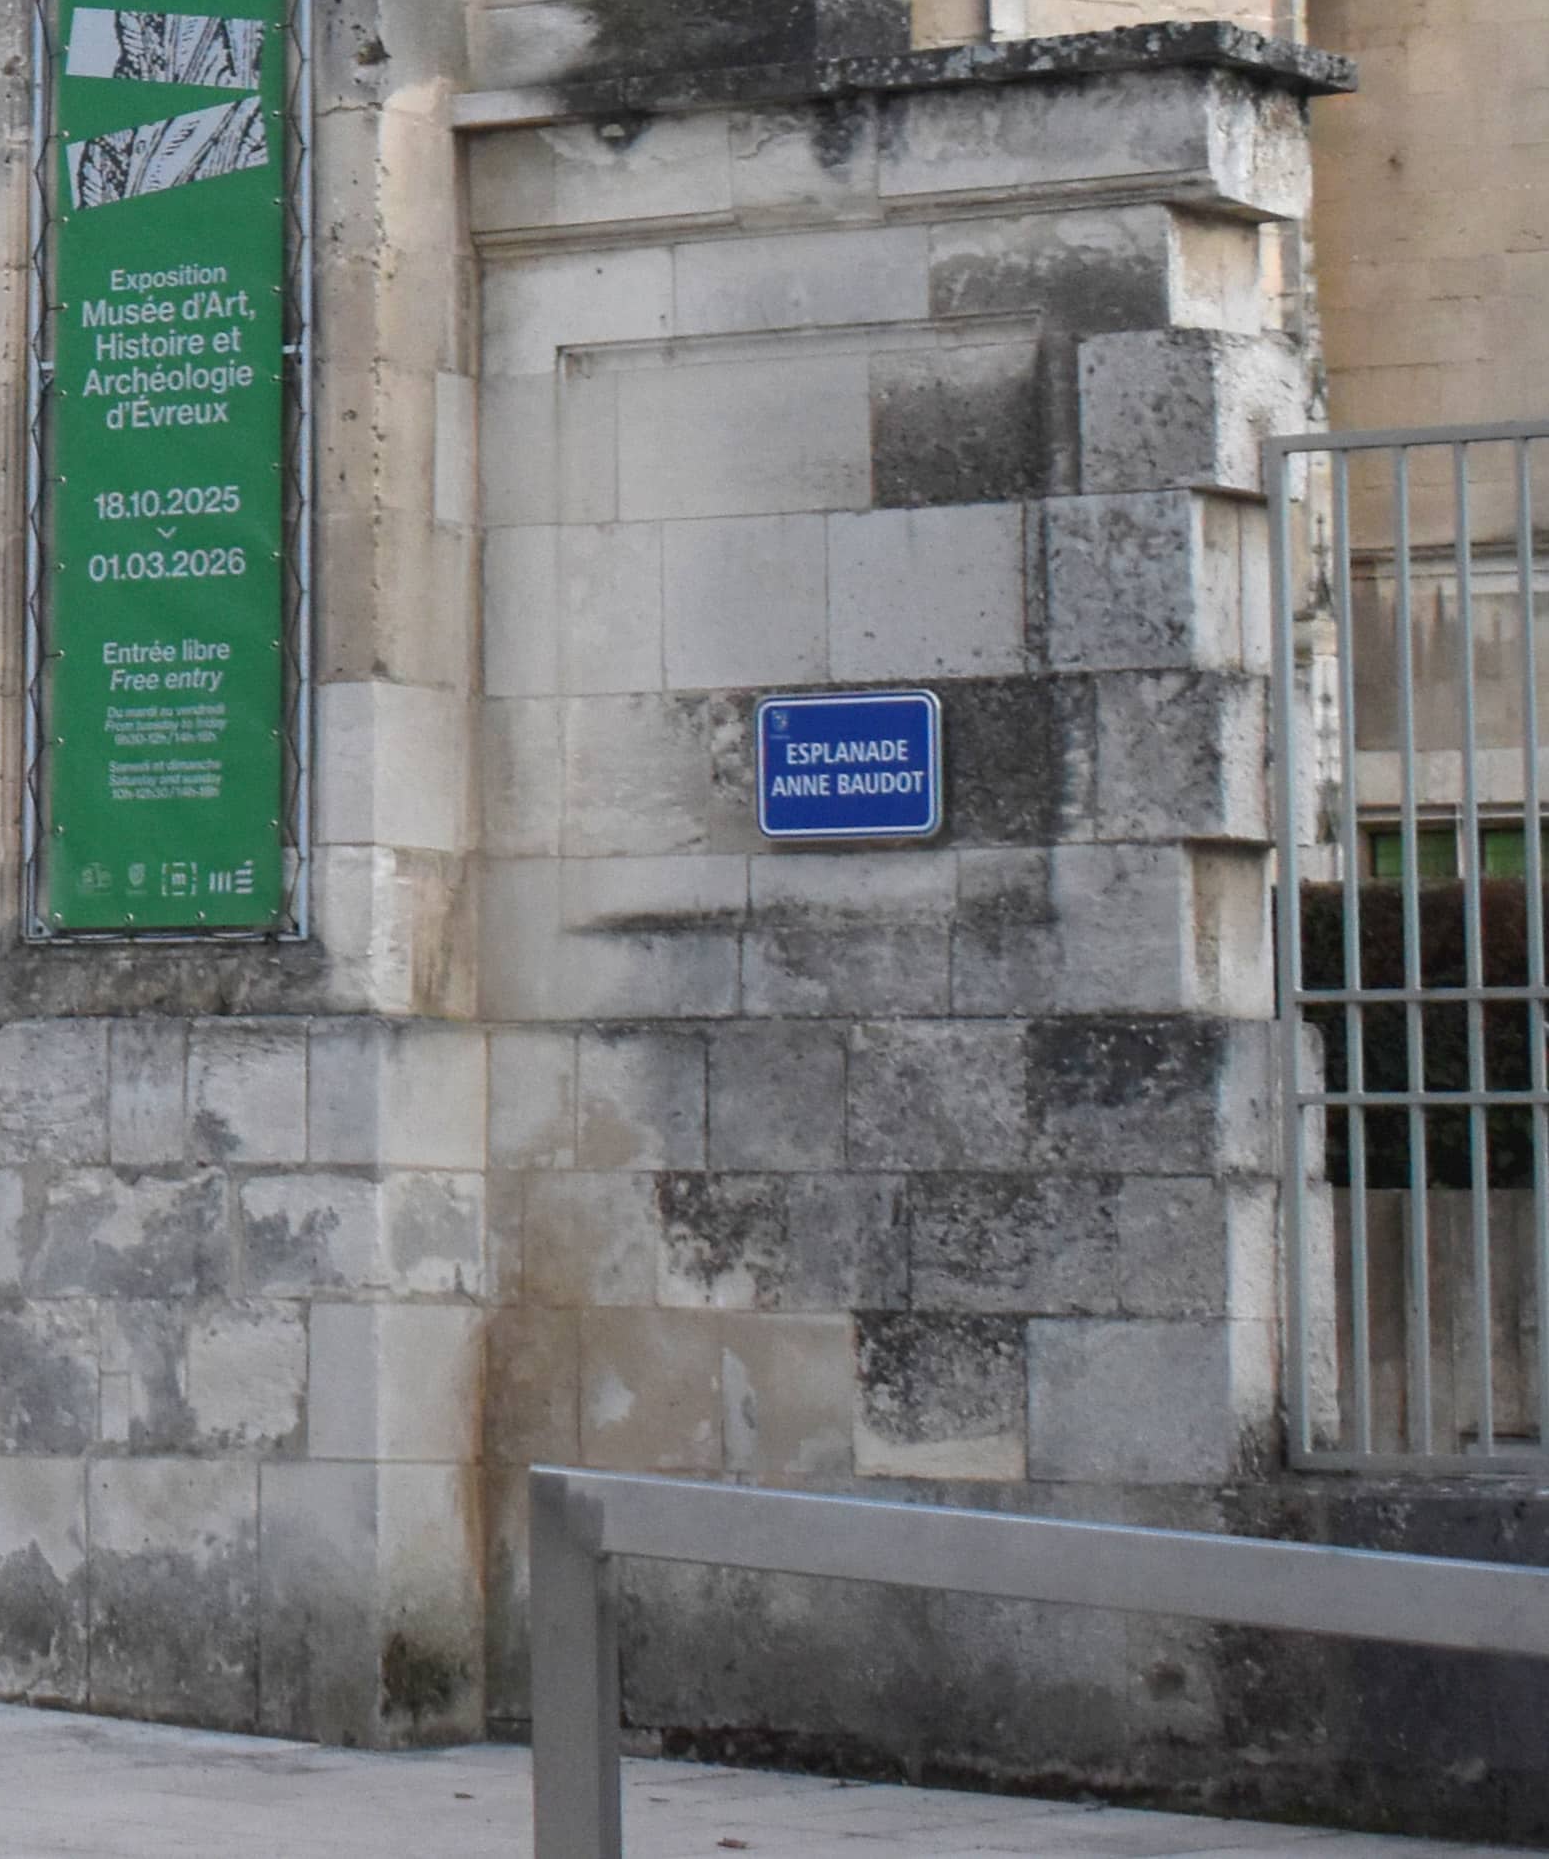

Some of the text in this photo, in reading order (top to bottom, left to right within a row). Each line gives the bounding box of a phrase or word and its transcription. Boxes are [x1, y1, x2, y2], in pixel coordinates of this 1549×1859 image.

[110, 264, 227, 293] Exposition
[82, 291, 255, 328] Musée d'Art,
[96, 326, 241, 361] Histoire et
[83, 359, 254, 397] Archéologie
[106, 395, 229, 430] d'Évreux
[94, 486, 240, 519] 18.10.2025
[88, 548, 246, 581] 01.03.2026
[103, 639, 231, 665] Entrée libre
[110, 669, 223, 692] Free entry
[786, 740, 909, 765] ESPLANADE
[771, 771, 924, 797] ANNE BAUDOT
